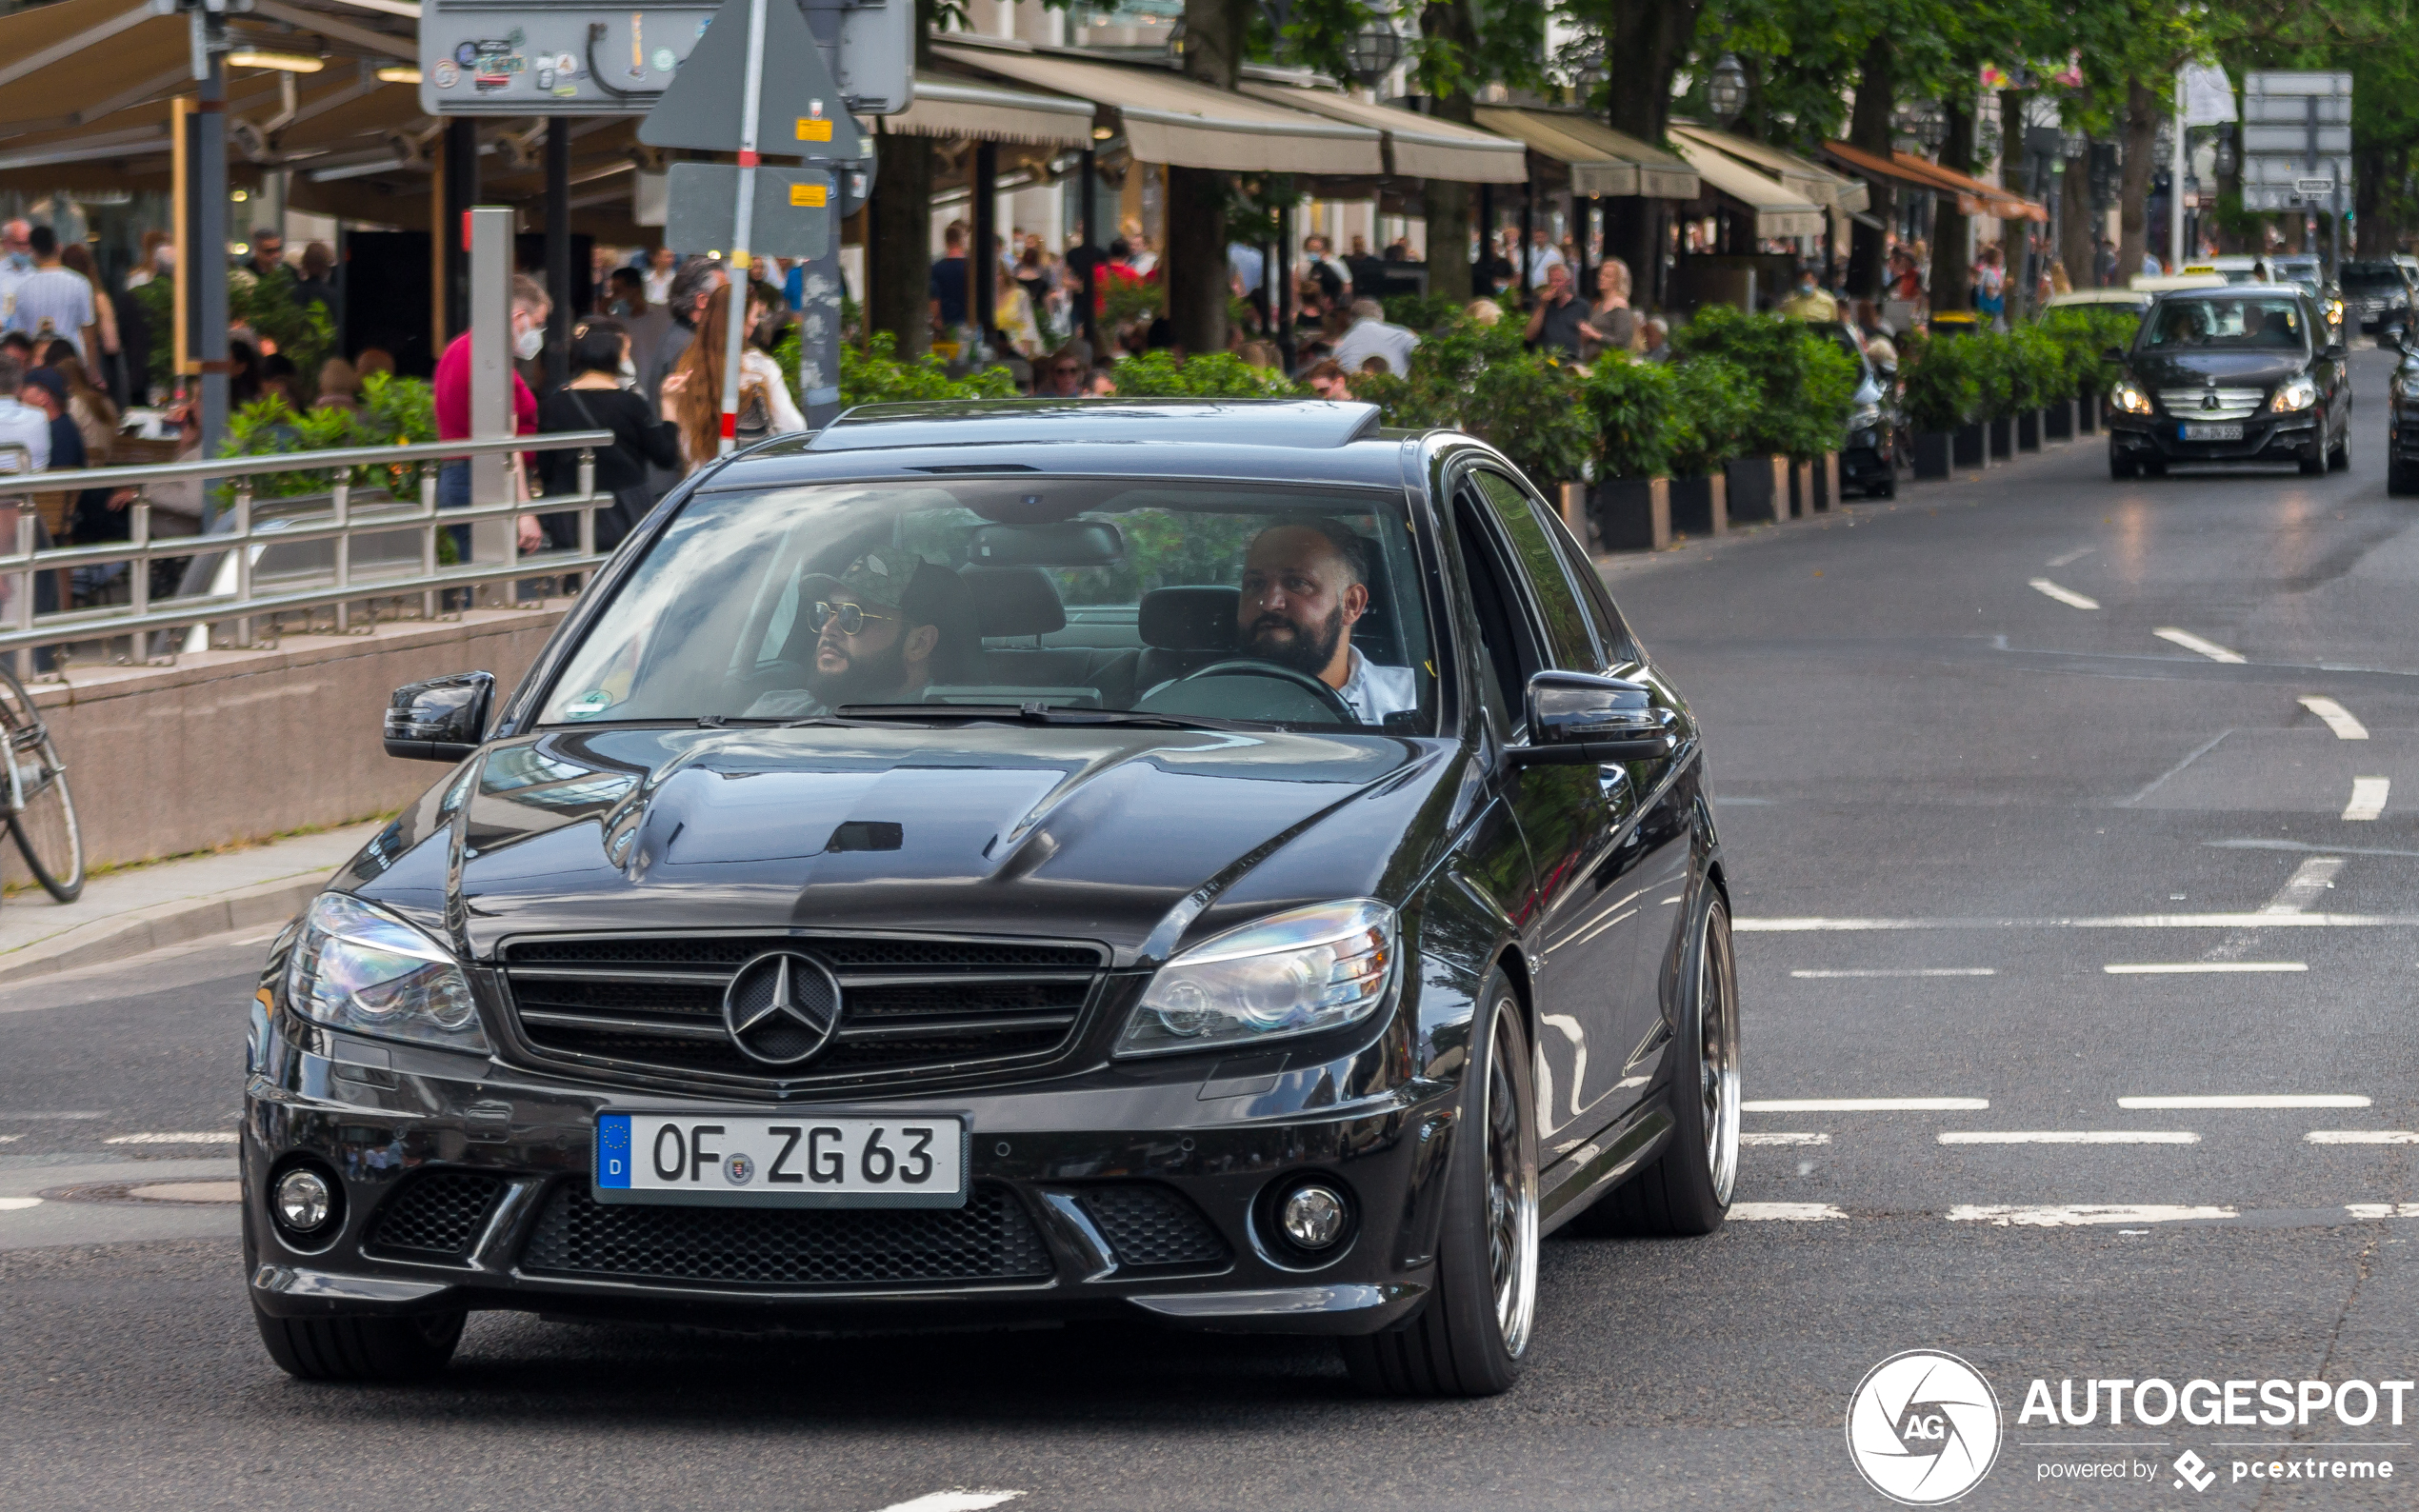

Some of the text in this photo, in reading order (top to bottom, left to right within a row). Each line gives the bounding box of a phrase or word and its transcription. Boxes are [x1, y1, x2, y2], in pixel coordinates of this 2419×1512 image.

[610, 1159, 622, 1175] D
[653, 1123, 934, 1184] OF ZG 63
